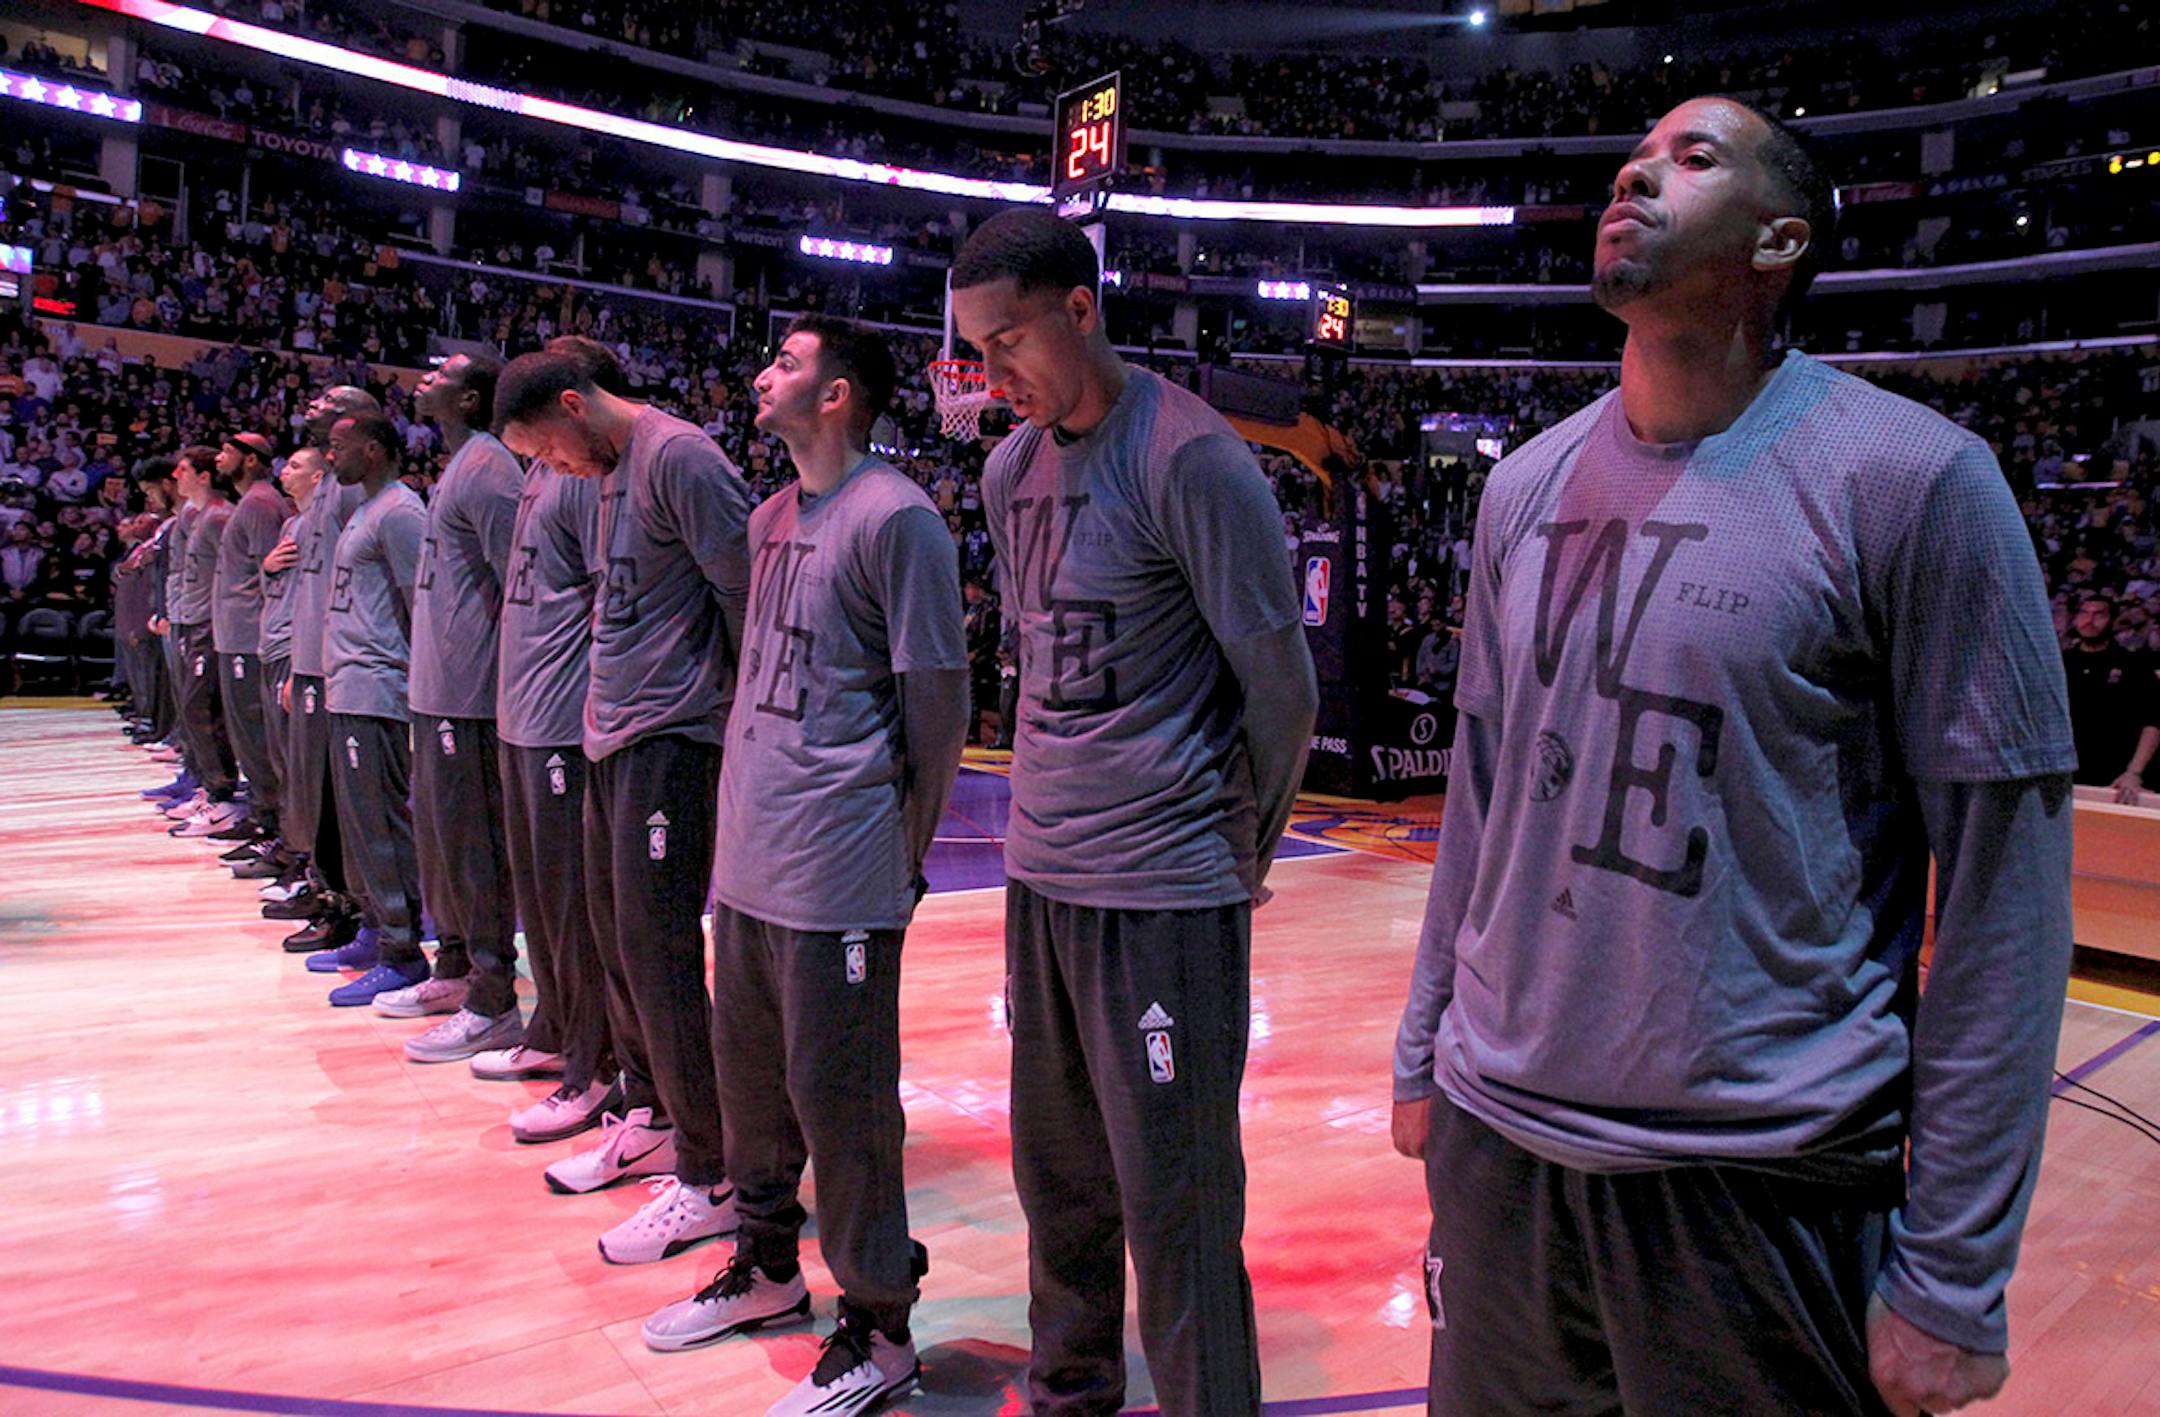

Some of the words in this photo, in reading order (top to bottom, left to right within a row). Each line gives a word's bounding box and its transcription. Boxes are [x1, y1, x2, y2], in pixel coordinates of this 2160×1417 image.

[1081, 87, 1116, 123] 1:30
[250, 129, 337, 162] TOYOTA
[1067, 121, 1111, 179] 24
[1319, 313, 1345, 340] 24
[1674, 581, 1750, 615] FLIP
[1534, 518, 1725, 898] WE
[1321, 736, 1348, 755] PASS
